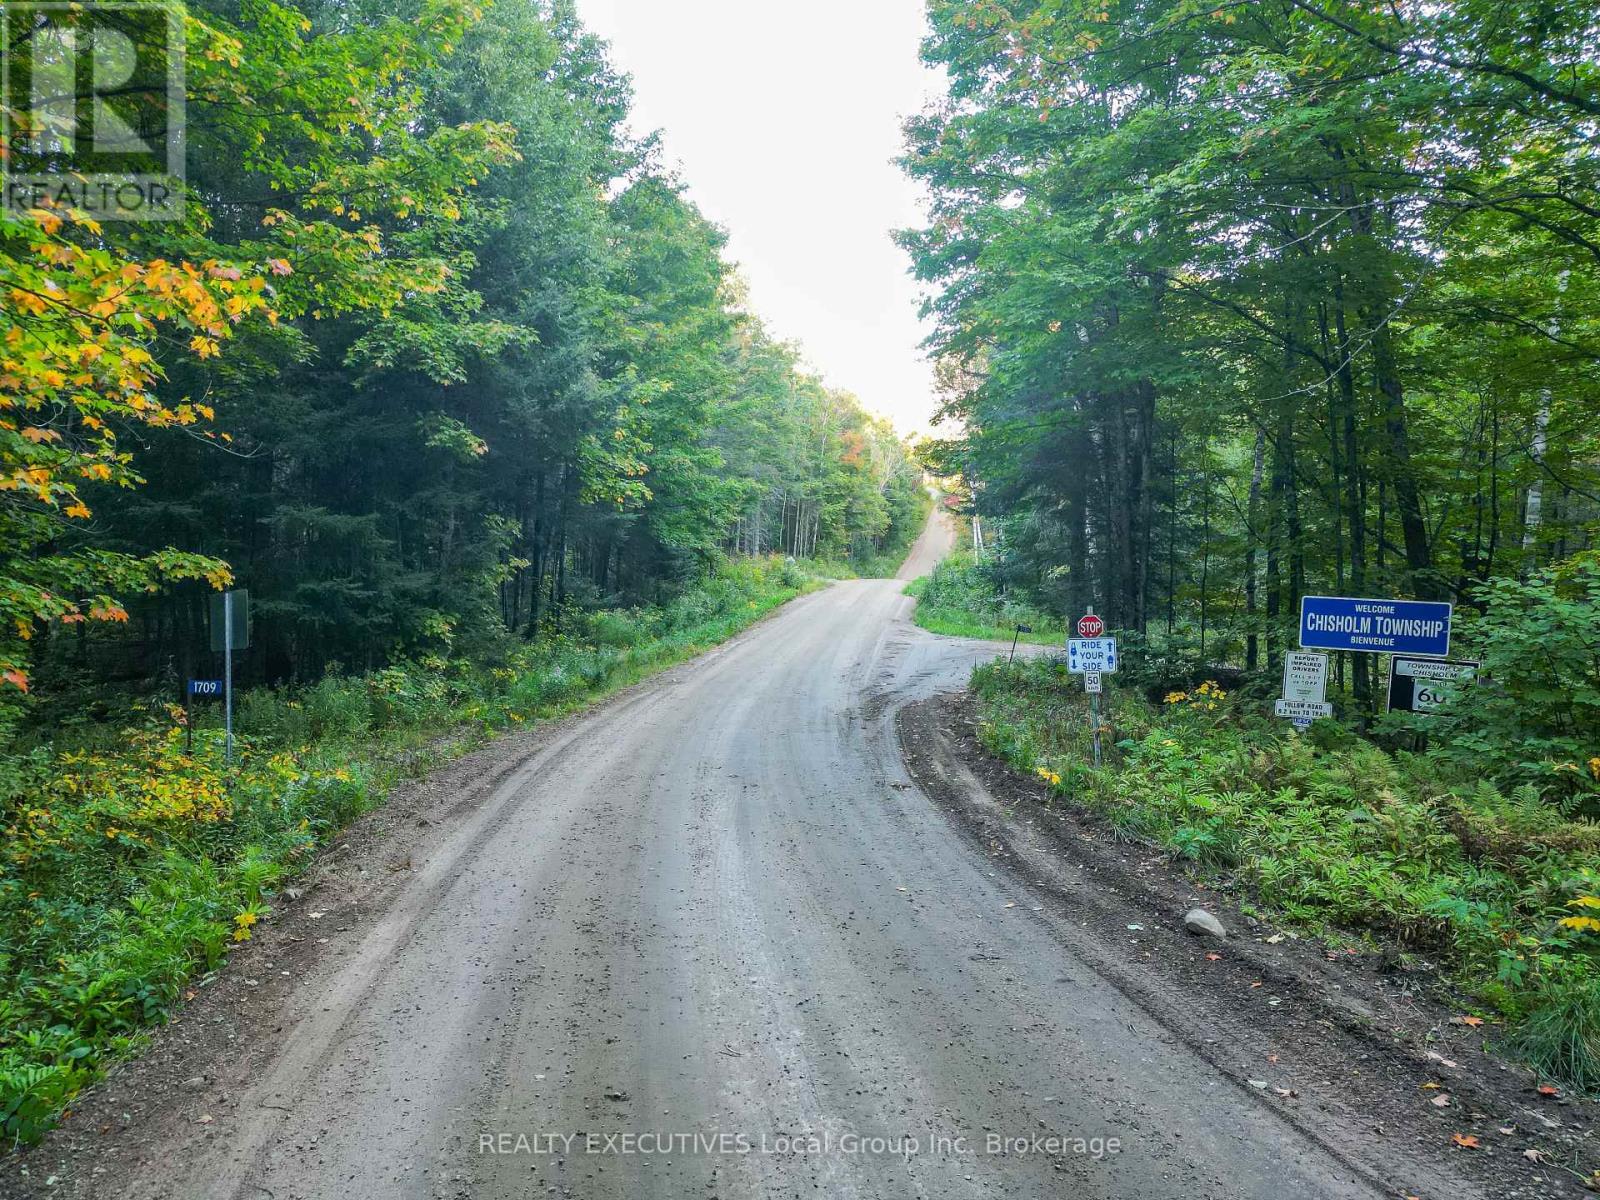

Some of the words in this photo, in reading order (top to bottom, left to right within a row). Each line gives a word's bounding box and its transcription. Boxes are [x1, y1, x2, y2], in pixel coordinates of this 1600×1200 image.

[1355, 604, 1395, 614] WELCOME
[1080, 621, 1101, 633] STOP
[1306, 612, 1371, 634] CHISHOLM
[1375, 616, 1443, 638] TOWNSHIP
[1081, 641, 1102, 649] RIDE
[1350, 636, 1395, 646] BIENVENUE
[1080, 651, 1104, 660] YOUR
[1082, 662, 1102, 670] SIDE
[1407, 662, 1451, 671] TOWNSHIP
[1412, 670, 1457, 679] CHISHOLM
[1087, 676, 1099, 685] 50
[194, 681, 217, 693] 1709
